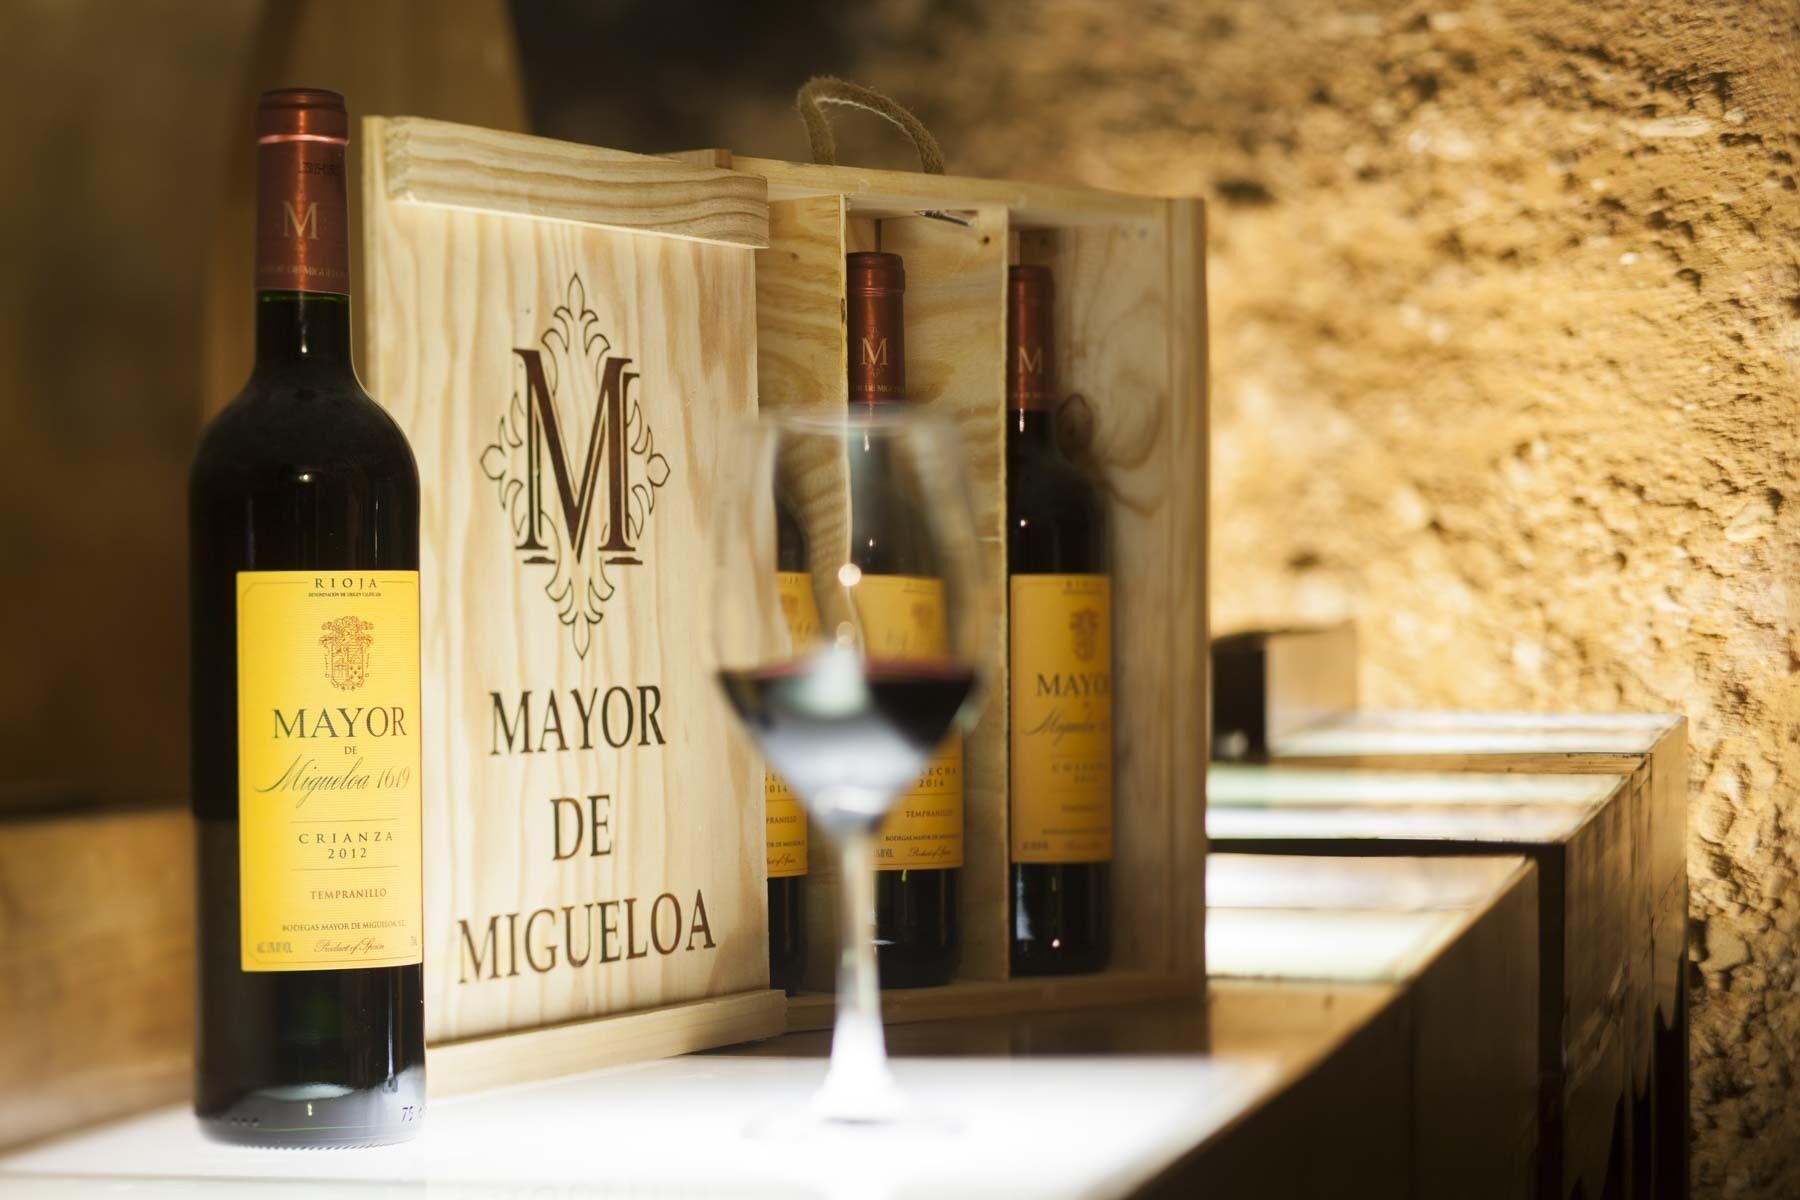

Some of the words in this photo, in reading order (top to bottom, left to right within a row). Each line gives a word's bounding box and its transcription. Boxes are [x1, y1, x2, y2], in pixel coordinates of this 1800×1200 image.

[282, 201, 319, 240] M
[861, 337, 888, 366] M
[1018, 347, 1043, 375] M
[513, 348, 643, 565] M
[315, 577, 377, 590] RIOJA
[272, 706, 407, 739] MAYOR
[489, 684, 667, 756] MAYOR
[344, 746, 358, 755] DE
[254, 753, 371, 809] Migueloa
[376, 766, 410, 789] 1619
[919, 778, 945, 788] 2014
[298, 831, 393, 844] CRIANZA
[549, 794, 613, 861] DE
[327, 847, 367, 859] 2012
[311, 888, 387, 900] TEMPRANILLO
[282, 923, 320, 932] BODEGAS
[321, 922, 349, 931] MAYOR
[351, 921, 361, 930] DE
[457, 888, 717, 985] MIGUELOA
